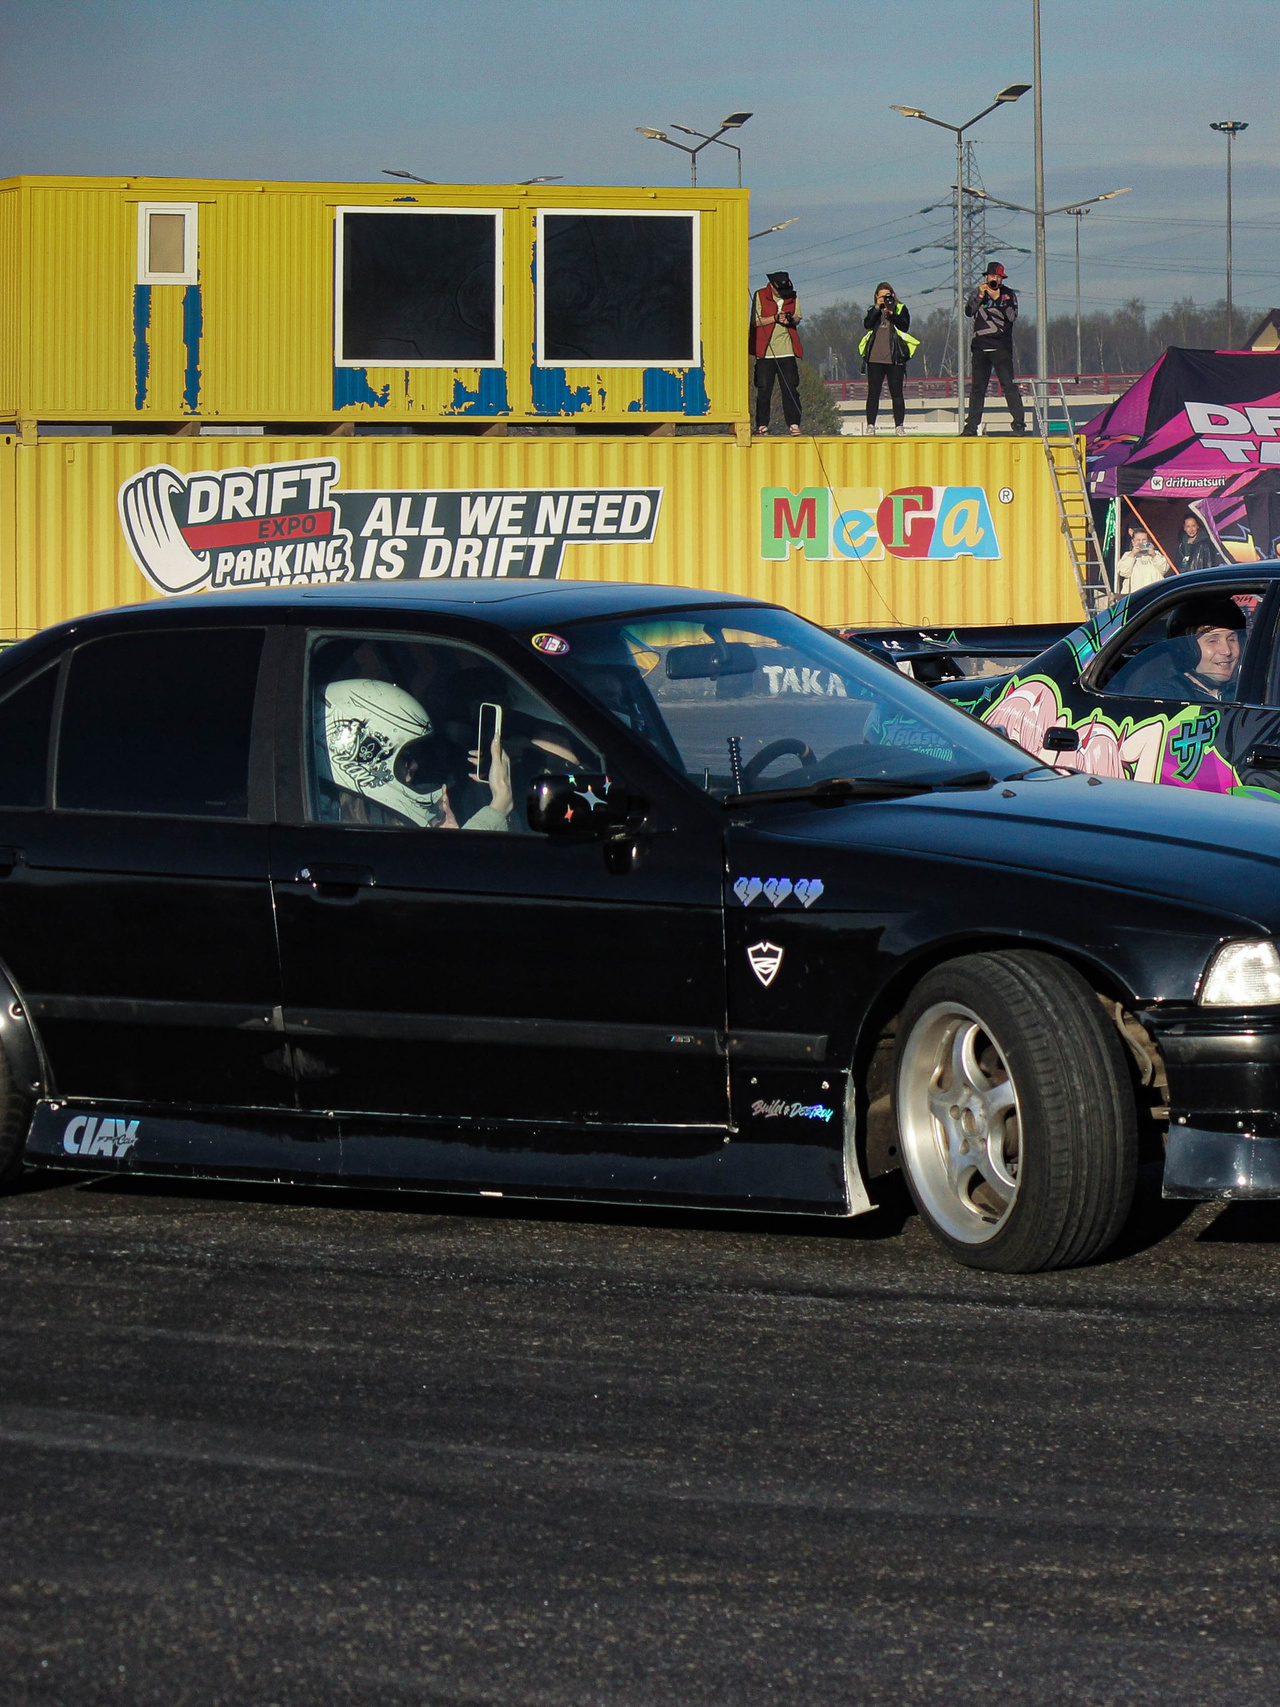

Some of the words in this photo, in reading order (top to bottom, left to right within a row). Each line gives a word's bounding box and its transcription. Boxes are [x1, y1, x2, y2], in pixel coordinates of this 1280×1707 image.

[187, 467, 335, 524] DRIFT
[1165, 476, 1226, 488] driftmatsuri
[258, 514, 317, 540] EXPO
[360, 496, 438, 537] ALL
[459, 495, 528, 535] WE
[535, 494, 653, 535] NEED
[215, 539, 344, 583] PARKING
[360, 538, 406, 580] IS
[419, 537, 556, 578] DRIFT
[1172, 713, 1218, 779] ザ
